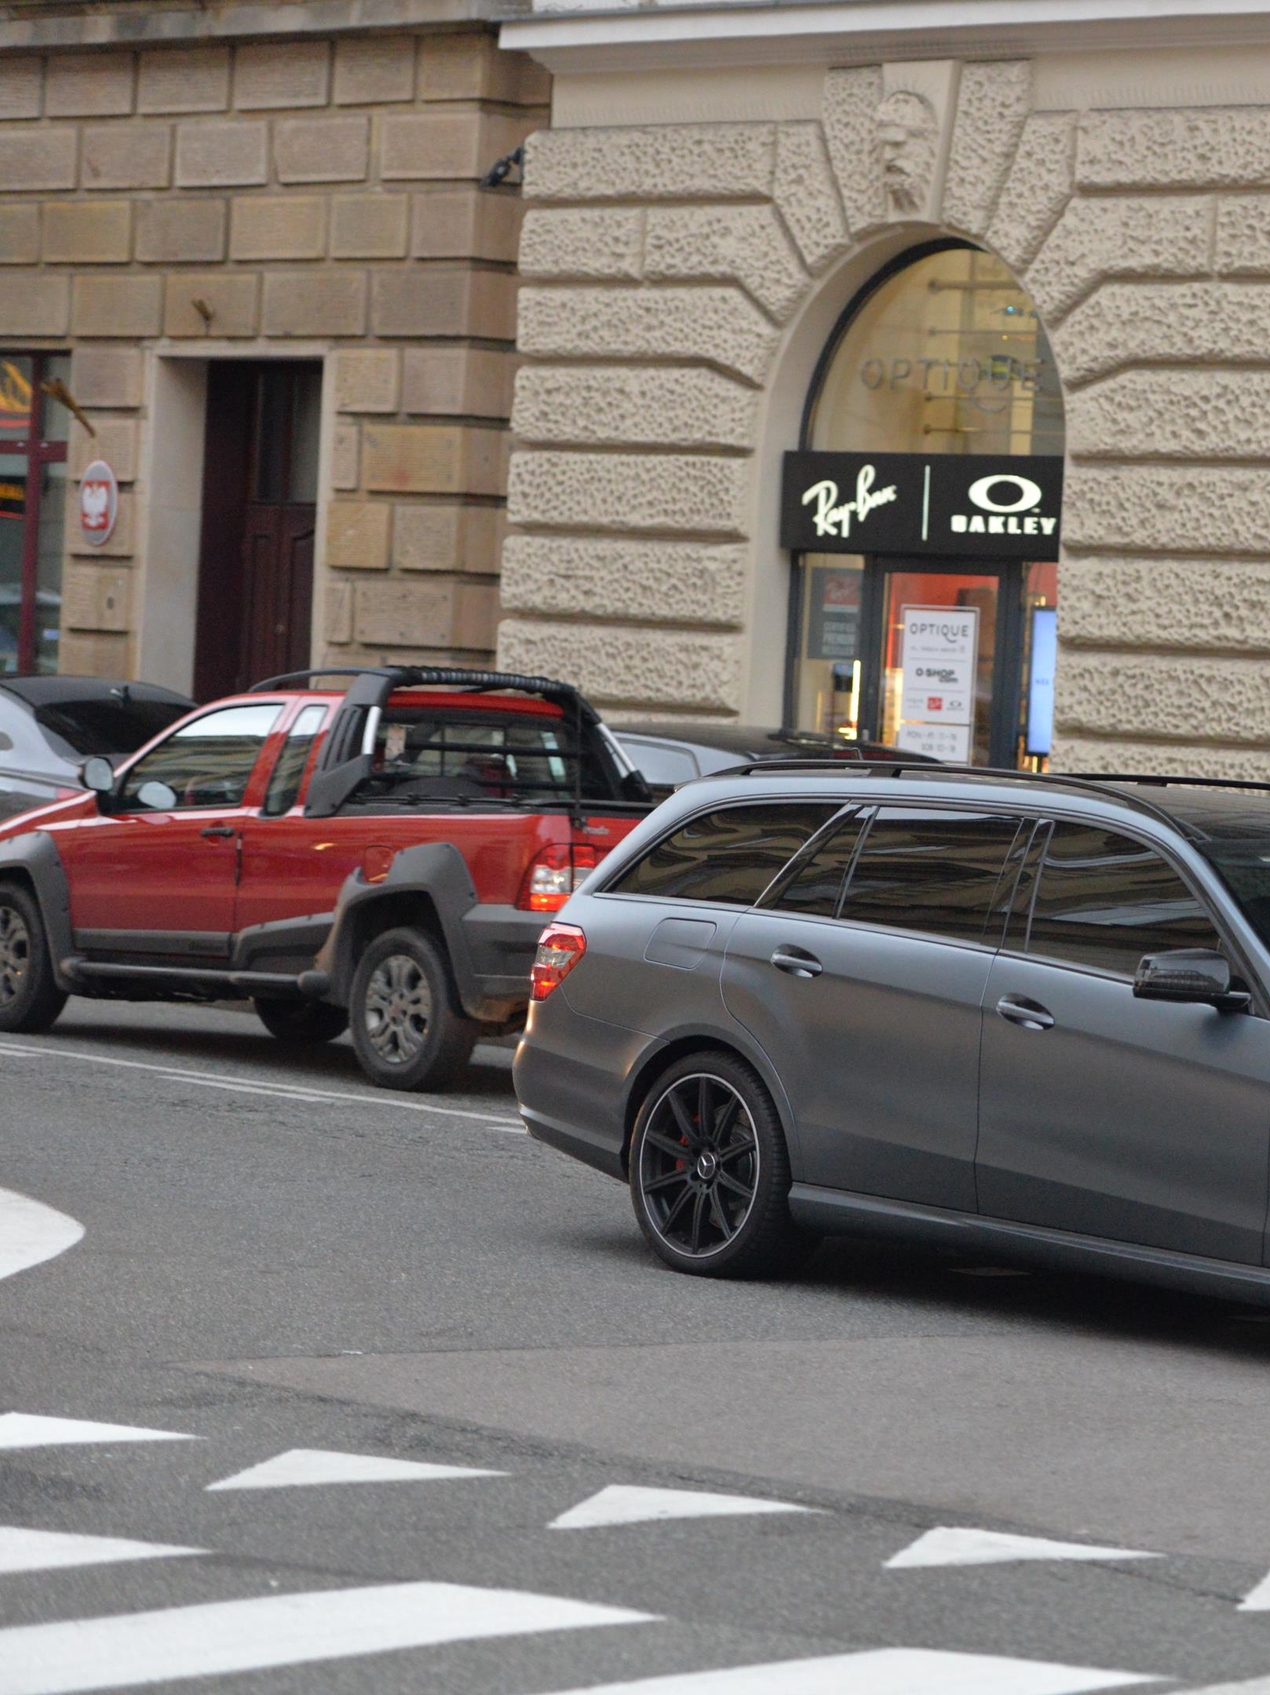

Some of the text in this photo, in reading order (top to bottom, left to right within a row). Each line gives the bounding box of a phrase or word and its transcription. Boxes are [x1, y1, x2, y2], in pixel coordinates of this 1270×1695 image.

[861, 358, 1044, 413] OPTIQUE
[950, 515, 1057, 535] OAKLEY
[909, 623, 968, 643] OPTIQUE
